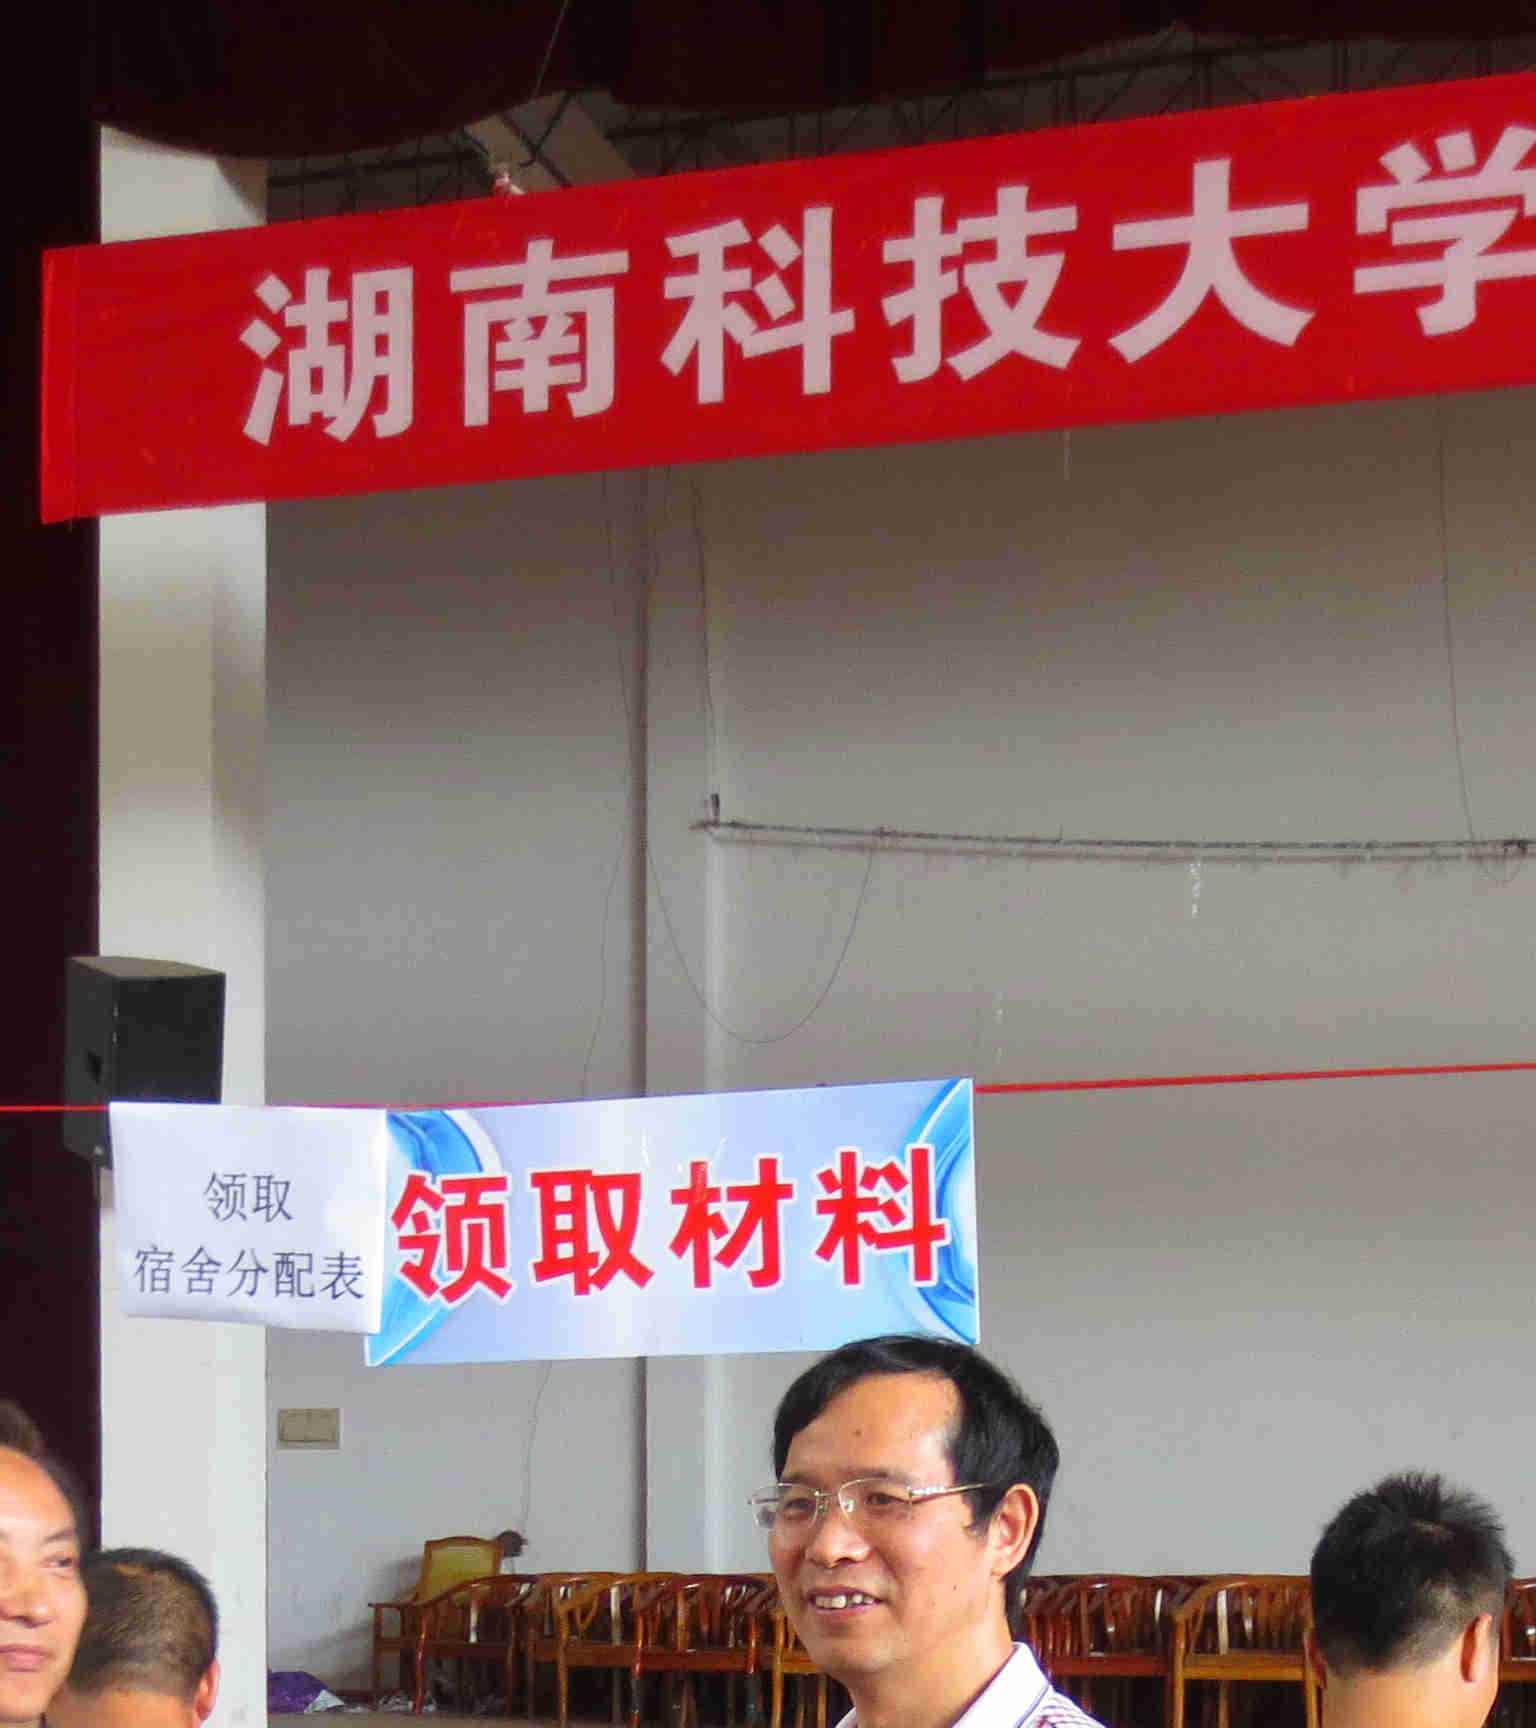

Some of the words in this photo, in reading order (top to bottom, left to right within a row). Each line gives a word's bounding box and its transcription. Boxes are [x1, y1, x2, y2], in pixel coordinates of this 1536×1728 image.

[203, 1171, 294, 1224] 领取
[390, 1147, 948, 1303] 领取材料
[133, 1244, 365, 1301] 宿舍分配表
